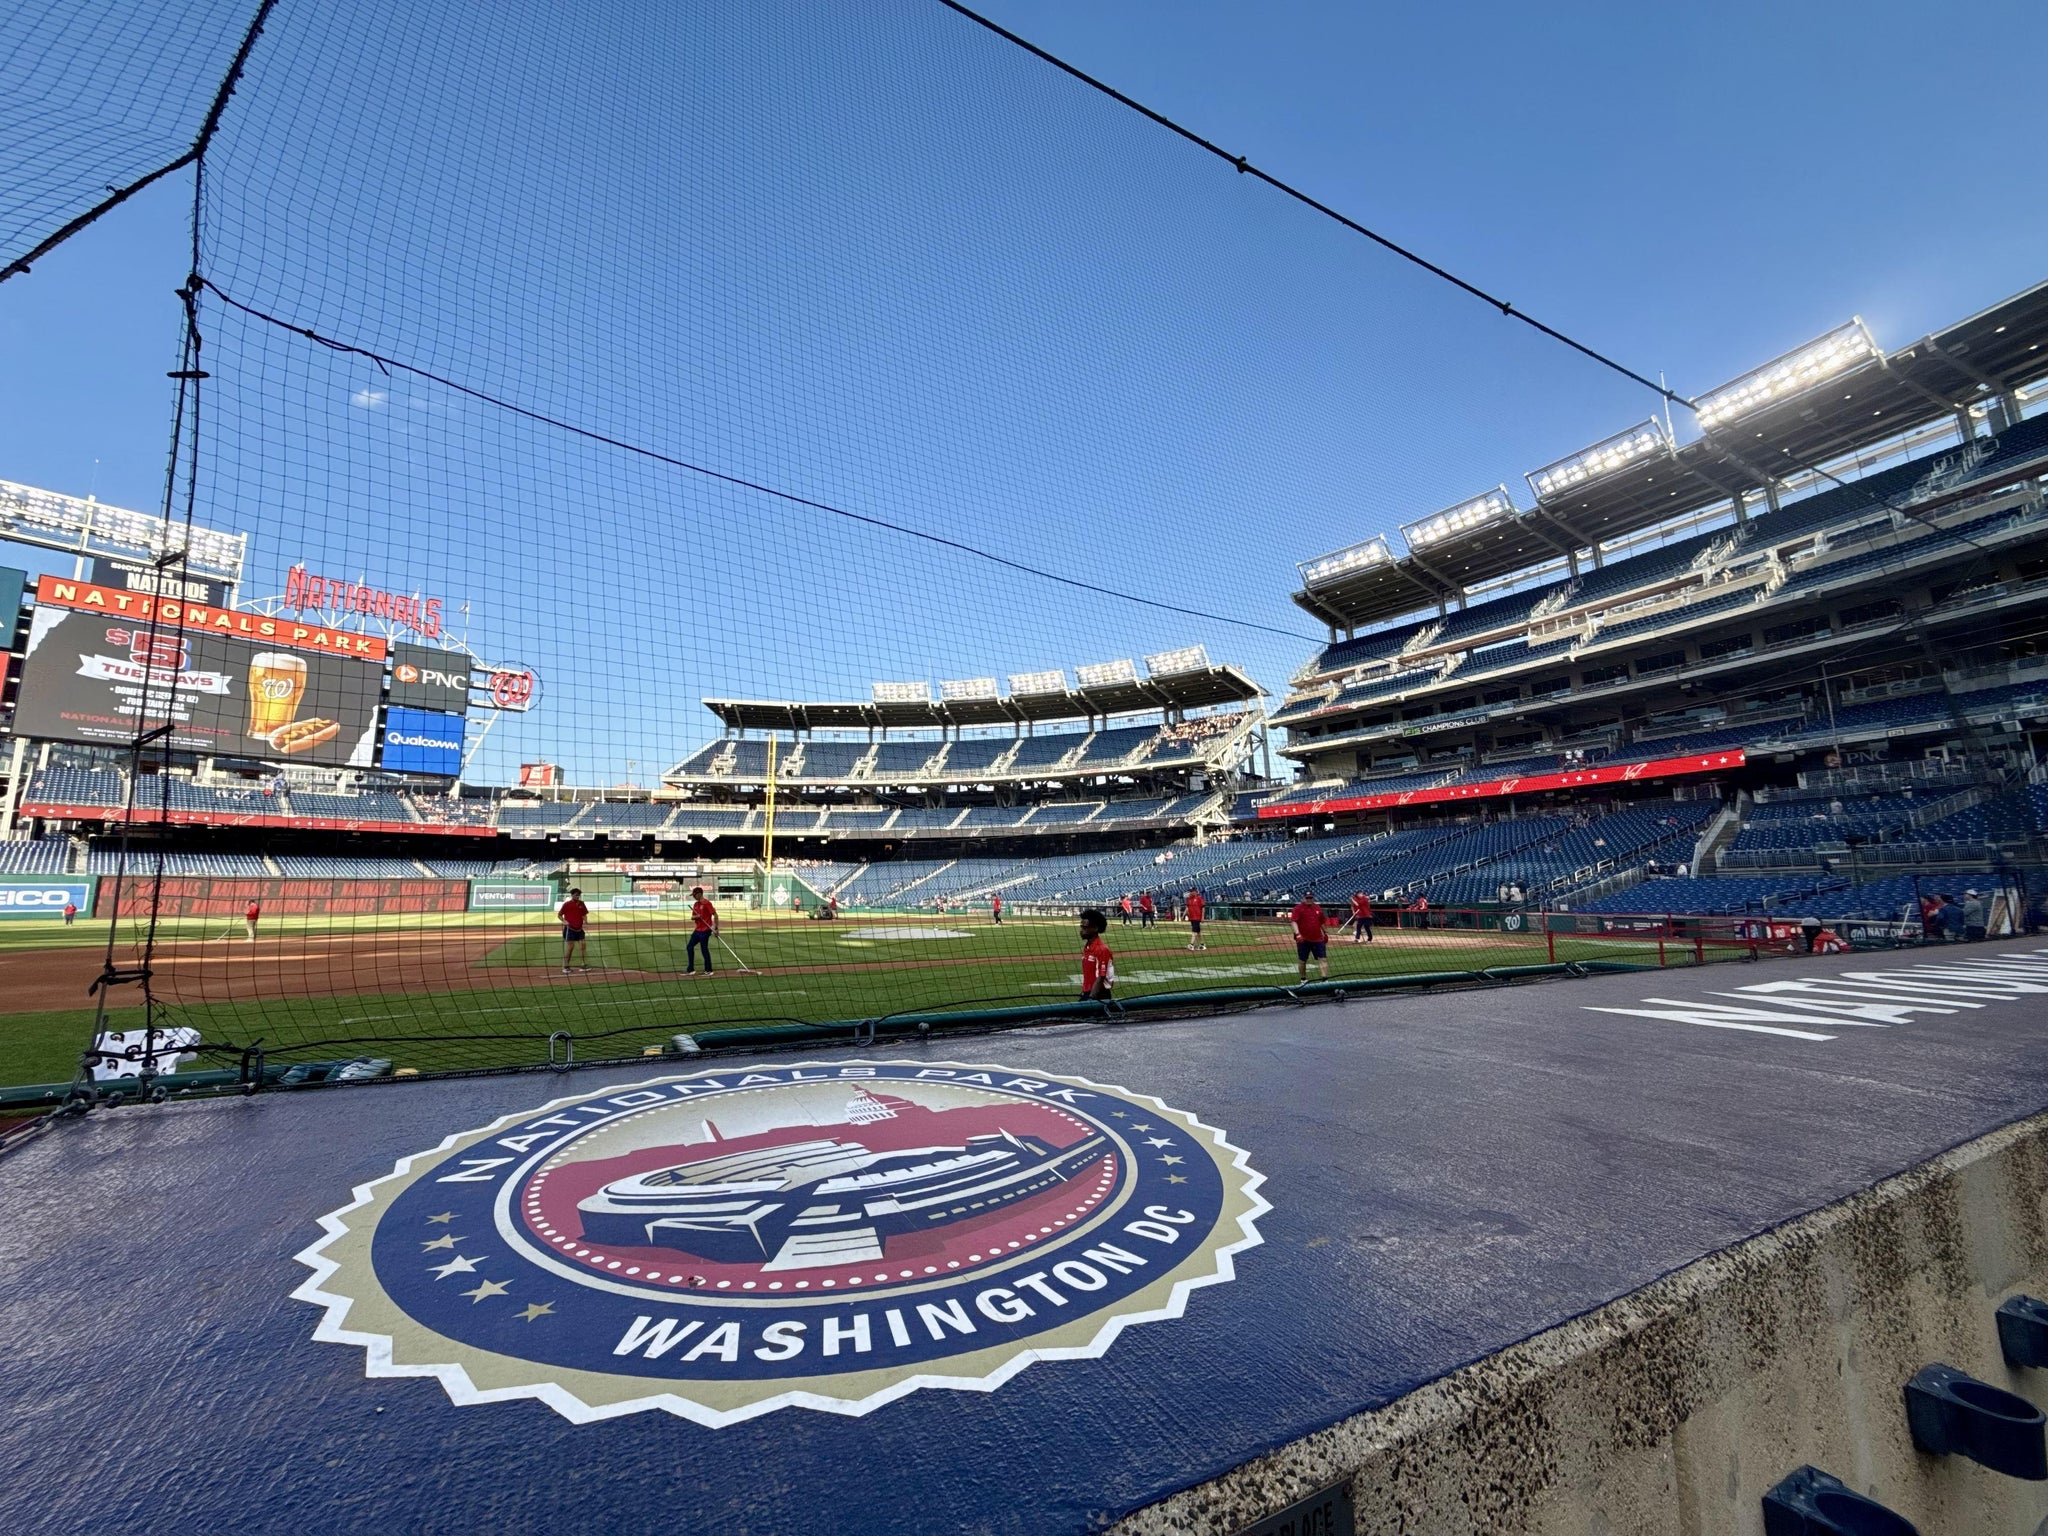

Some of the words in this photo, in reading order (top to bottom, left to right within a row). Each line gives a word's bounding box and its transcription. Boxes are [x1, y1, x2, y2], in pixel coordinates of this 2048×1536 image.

[110, 562, 143, 572] SHOW
[126, 572, 209, 600] NATITUDE
[284, 565, 442, 638] NATIONALS
[54, 583, 276, 636] NATIONALS
[293, 627, 372, 654] PARK
[105, 628, 192, 670] $5
[102, 662, 214, 687] TUESDAYS
[421, 668, 467, 690] PNC
[114, 686, 155, 698] DOMESIC
[126, 697, 164, 709] FOUTAIN
[1421, 720, 1465, 733] CHAMPIONS
[1465, 715, 1487, 725] CLUB
[387, 732, 460, 751] Qualcomm
[1846, 749, 1889, 765] PNC
[0, 890, 70, 905] EICO
[210, 881, 271, 896] NATIONALS
[279, 882, 333, 897] NATIONALS
[341, 882, 391, 896] NATIONALS
[399, 882, 445, 896] NATIONALS
[478, 892, 516, 900] VENTURE
[190, 900, 249, 914] NATIONALS
[260, 899, 315, 913] NATIONALS
[324, 898, 376, 912] NATIONALS
[383, 898, 430, 911] NATIONALS
[435, 1066, 877, 1183] NATIONALS
[915, 1068, 1097, 1103] PARK
[613, 1241, 1148, 1362] WASHINGTON
[1123, 1204, 1196, 1245] DC
